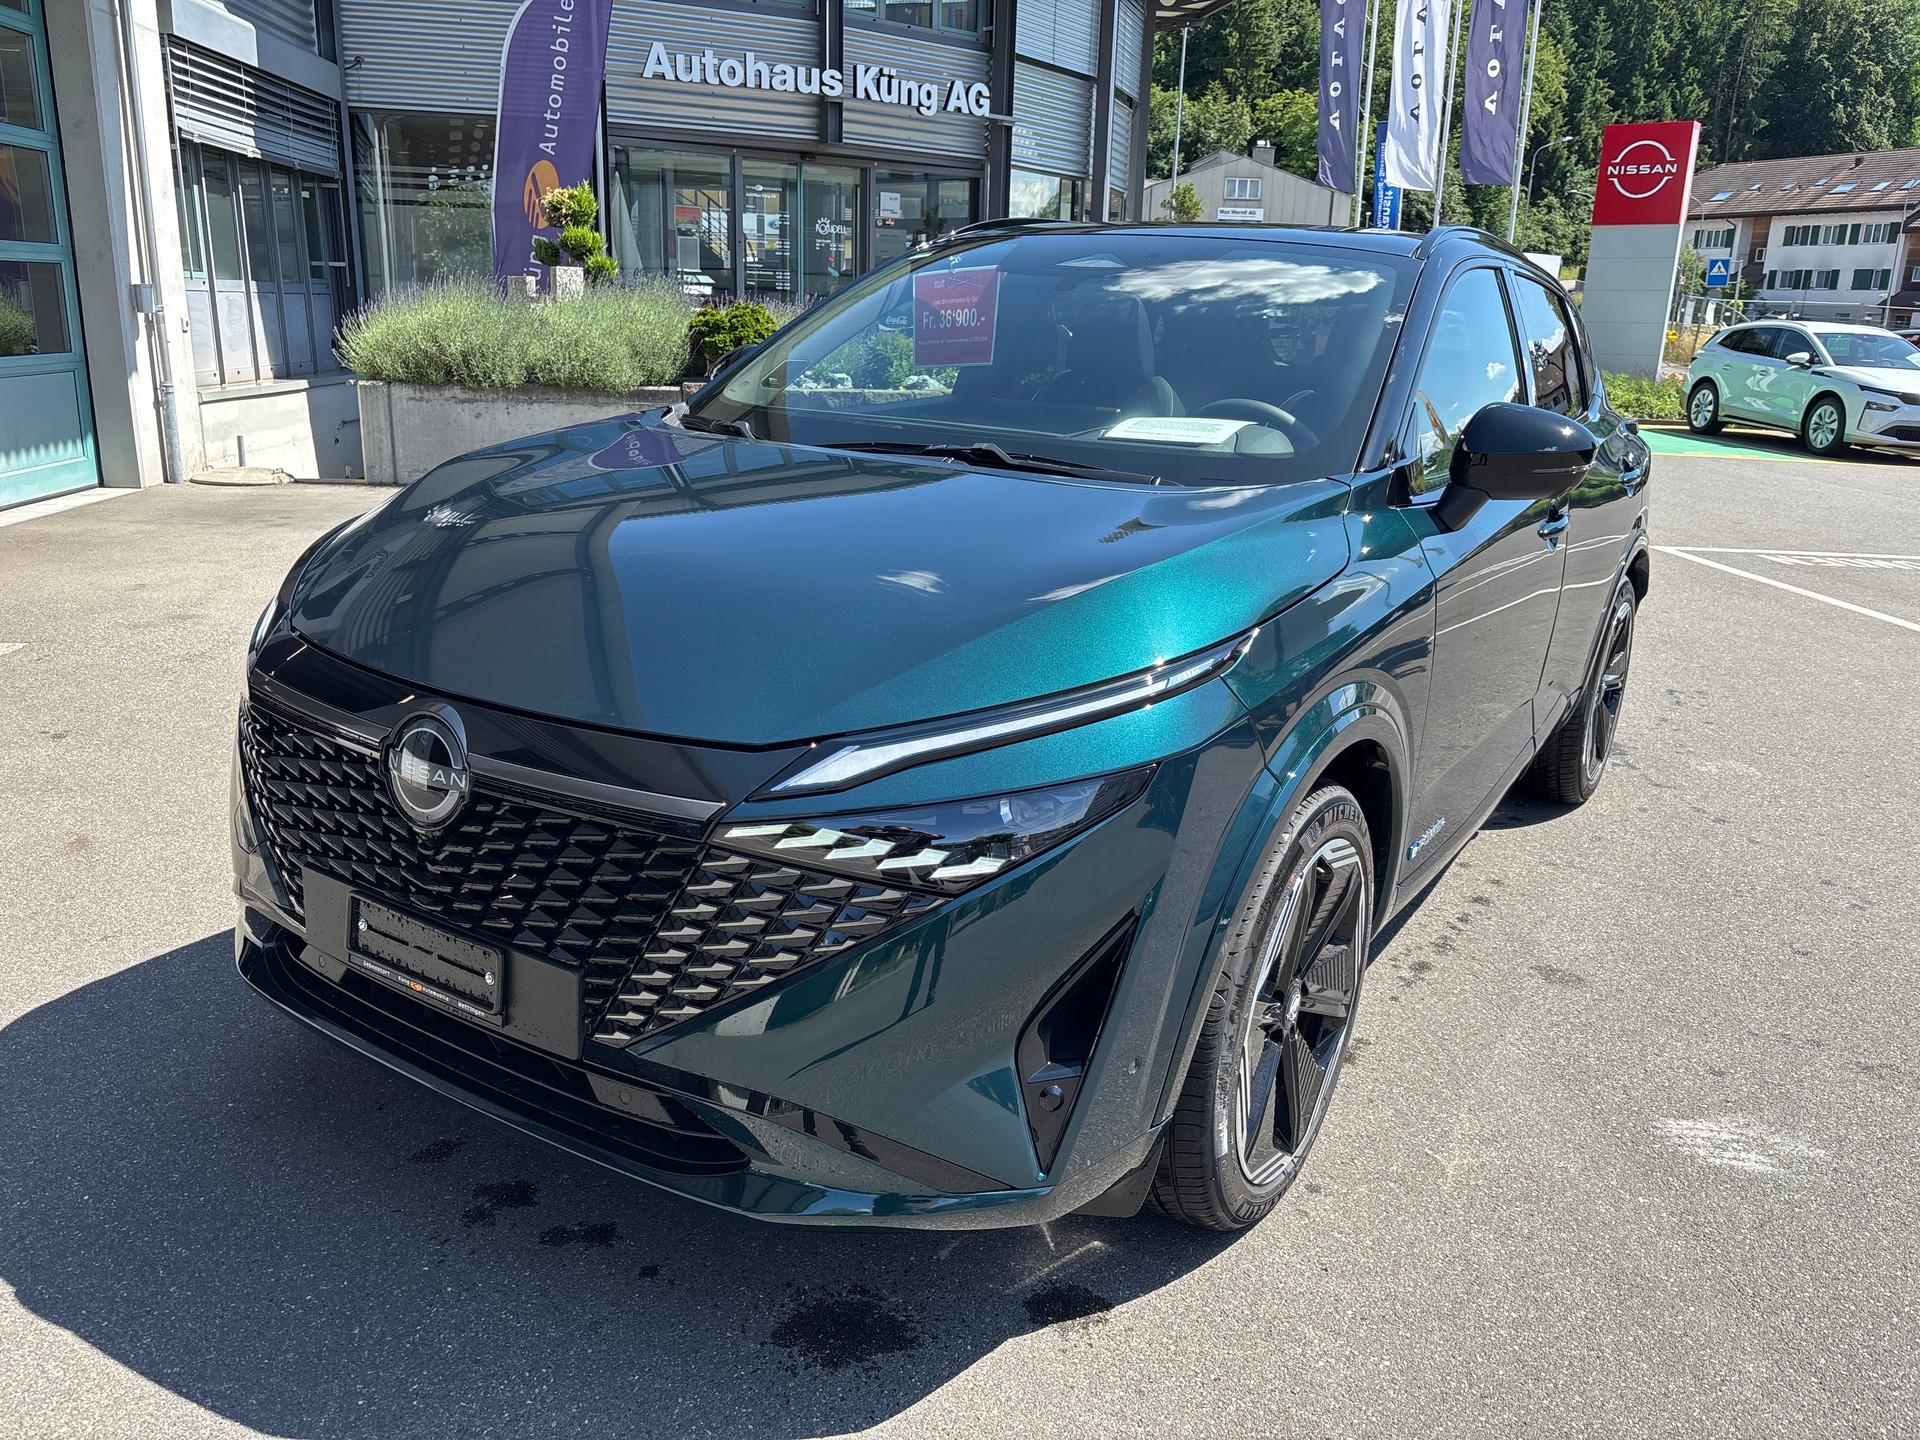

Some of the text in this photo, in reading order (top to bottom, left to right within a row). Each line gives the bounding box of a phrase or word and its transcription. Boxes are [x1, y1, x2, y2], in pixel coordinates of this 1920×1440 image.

[641, 41, 991, 117] Autohaus Küng AG
[1606, 163, 1678, 176] NISSAN
[922, 312, 936, 330] Fr.
[1324, 804, 1368, 836] MICHELIN
[457, 1001, 485, 1018] Wettingen
